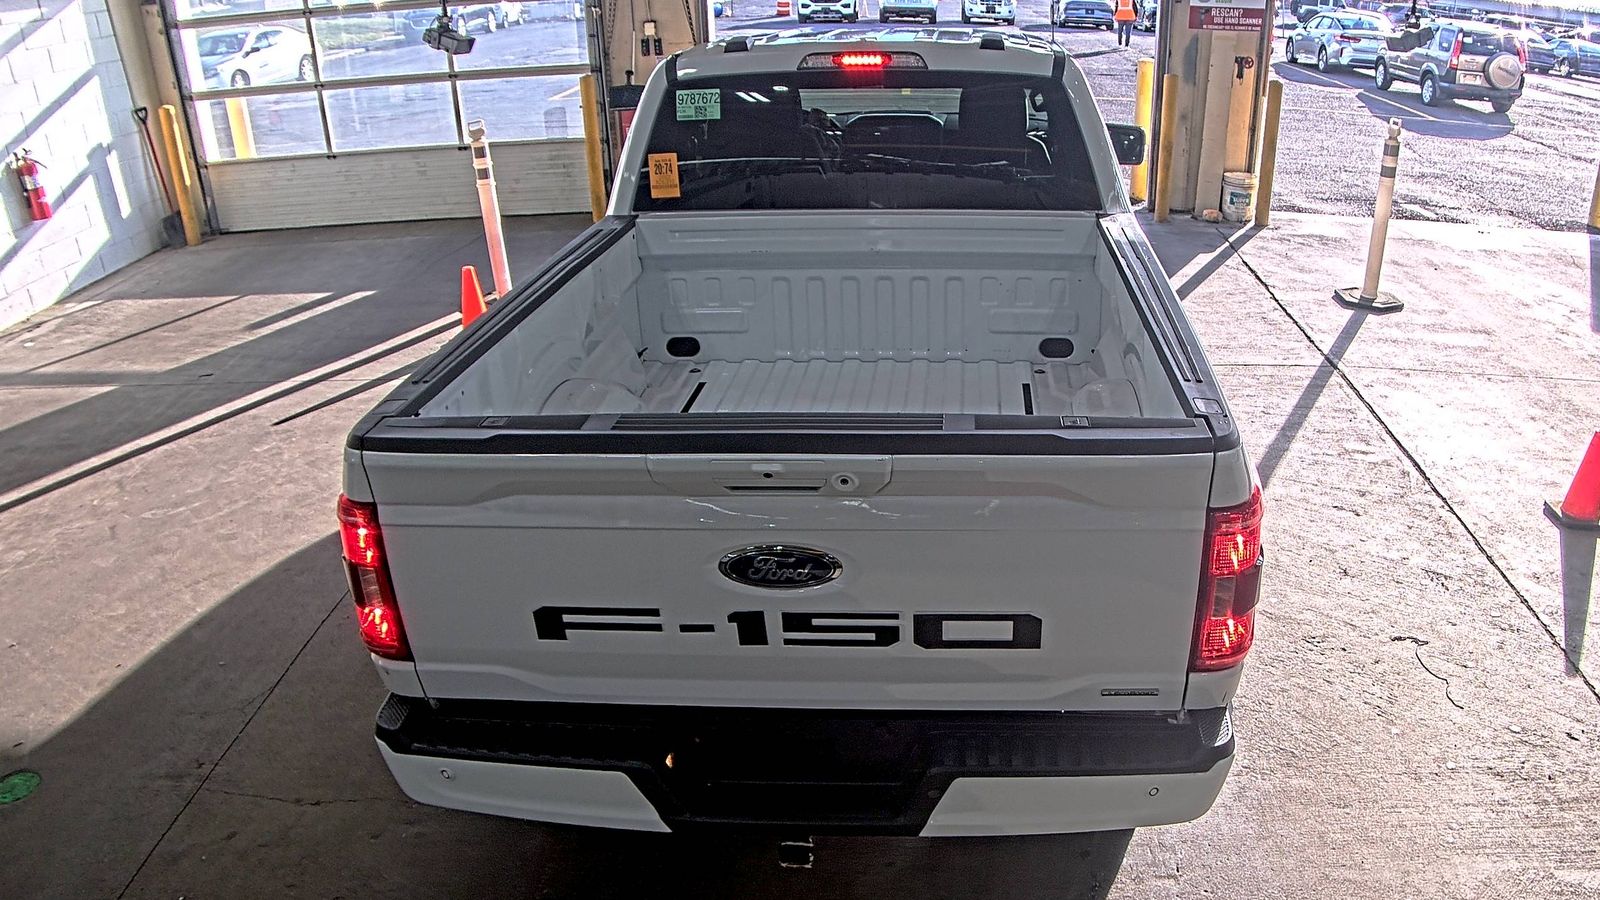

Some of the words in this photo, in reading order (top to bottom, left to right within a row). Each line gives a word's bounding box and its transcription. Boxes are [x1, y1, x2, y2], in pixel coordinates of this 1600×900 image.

[1211, 8, 1243, 17] RESCAN?
[678, 92, 720, 105] 9787672
[748, 556, 813, 581] Ford
[533, 606, 1043, 650] F-150
